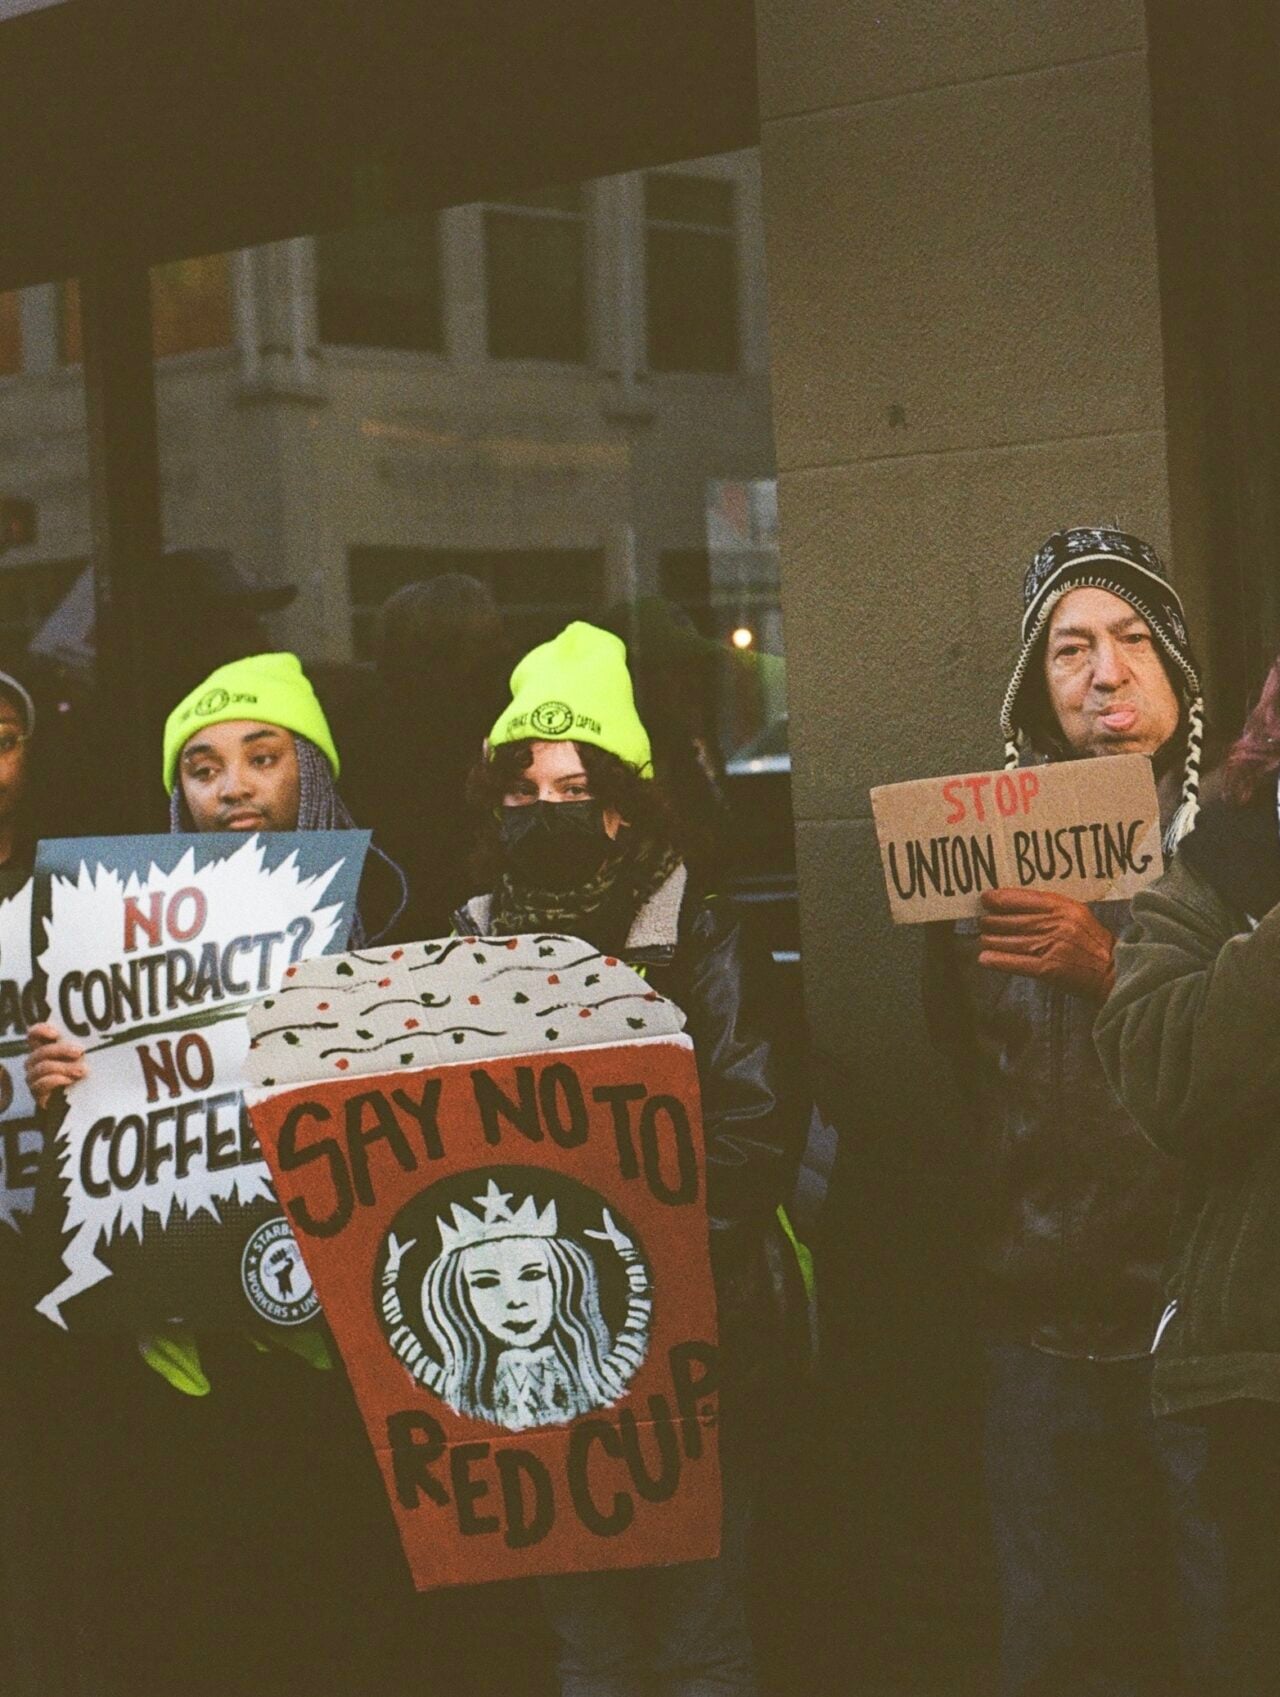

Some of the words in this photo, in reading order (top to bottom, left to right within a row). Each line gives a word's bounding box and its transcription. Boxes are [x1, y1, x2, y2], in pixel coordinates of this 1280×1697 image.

[942, 770, 1041, 825] STOP
[888, 833, 1000, 900] UNION
[1014, 819, 1154, 887] BUSTING
[123, 886, 208, 953] NO
[58, 916, 314, 1037] CONTRACT?
[136, 1033, 214, 1102] NO
[277, 1078, 446, 1240] SAY
[470, 1062, 590, 1150] NO
[592, 1083, 698, 1206] TO
[247, 1269, 288, 1318] WORKERS
[386, 1409, 556, 1548] RED
[566, 1338, 720, 1538] CUP
